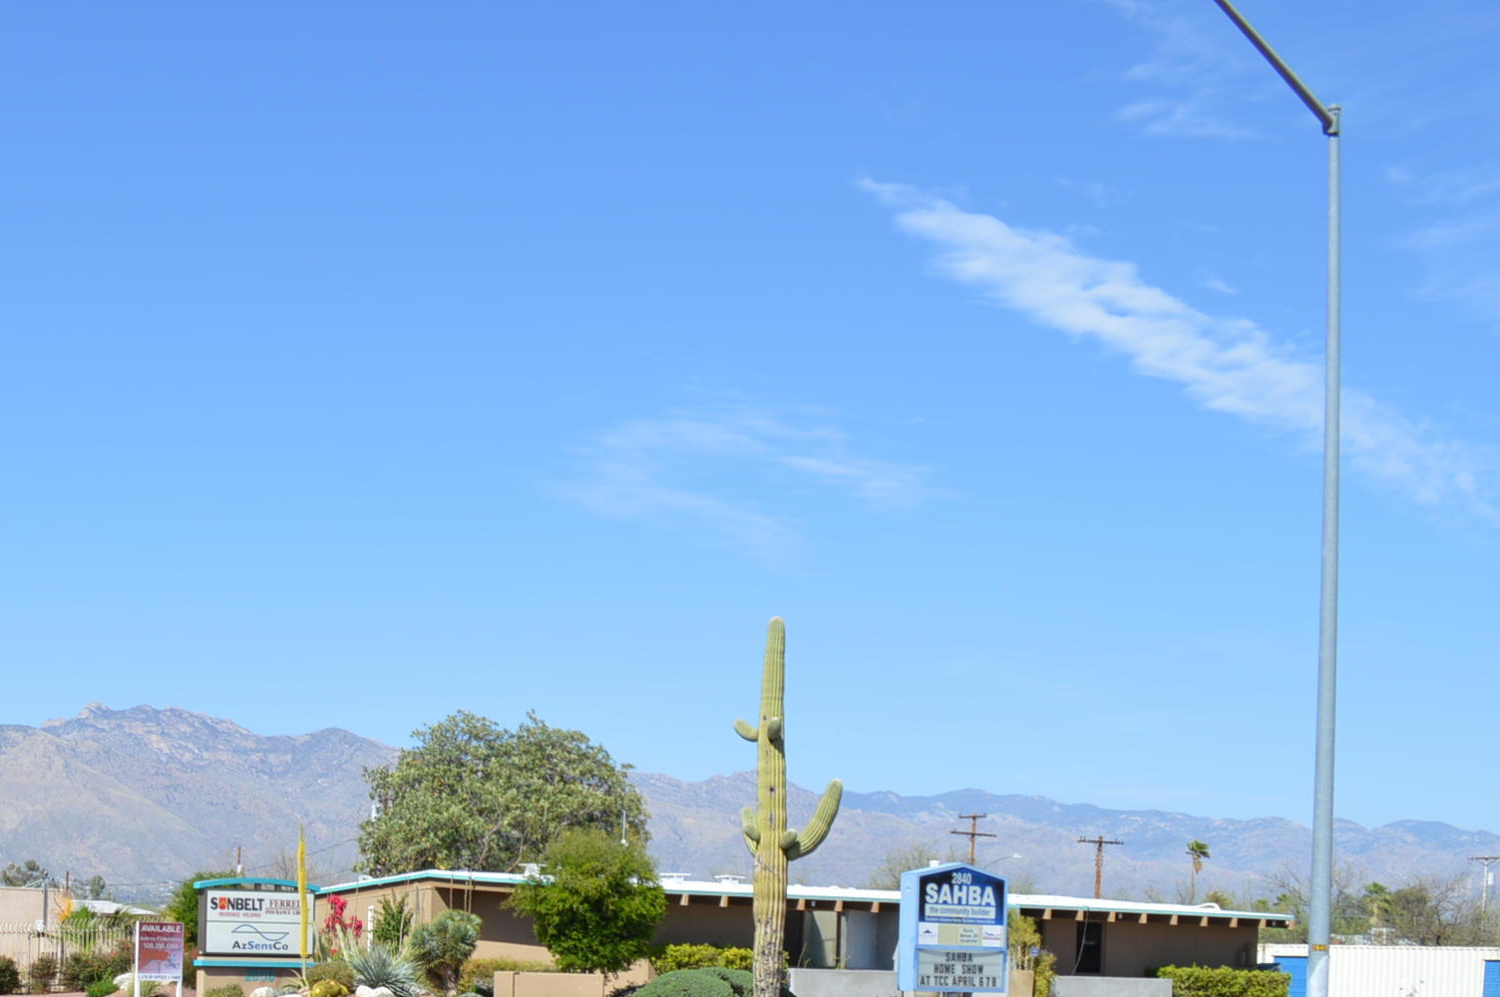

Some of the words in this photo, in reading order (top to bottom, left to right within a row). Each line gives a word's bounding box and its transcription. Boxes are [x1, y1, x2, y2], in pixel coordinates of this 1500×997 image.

[925, 883, 996, 906] SAHBA
[141, 924, 181, 933] AVAILABLE
[231, 940, 289, 951] AzSensCo
[944, 952, 973, 962] SAHBA
[933, 963, 956, 974] HOME
[961, 964, 984, 975] SHOW
[920, 975, 931, 986] AT
[934, 976, 949, 987] TCC
[952, 976, 976, 988] APRIL
